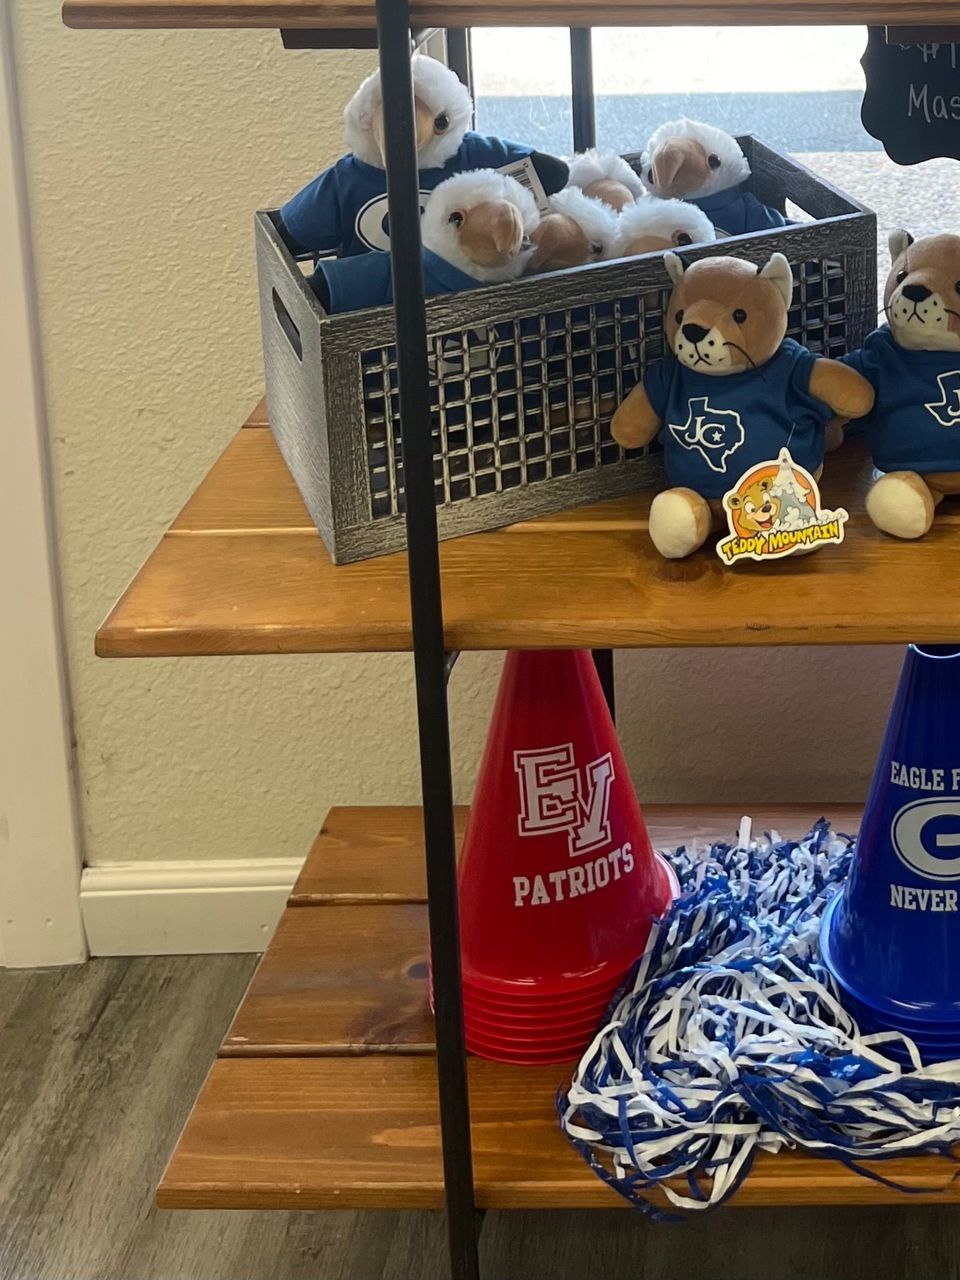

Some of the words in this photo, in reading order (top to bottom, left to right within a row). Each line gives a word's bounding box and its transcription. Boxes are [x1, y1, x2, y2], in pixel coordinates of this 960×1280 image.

[685, 415, 726, 449] JC
[720, 534, 767, 561] TEDDY
[768, 519, 841, 552] MOUNTAIN
[890, 759, 945, 791] EAGLE
[513, 742, 615, 858] EV
[512, 842, 635, 908] PATRIOTS
[889, 883, 959, 913] NEVER
